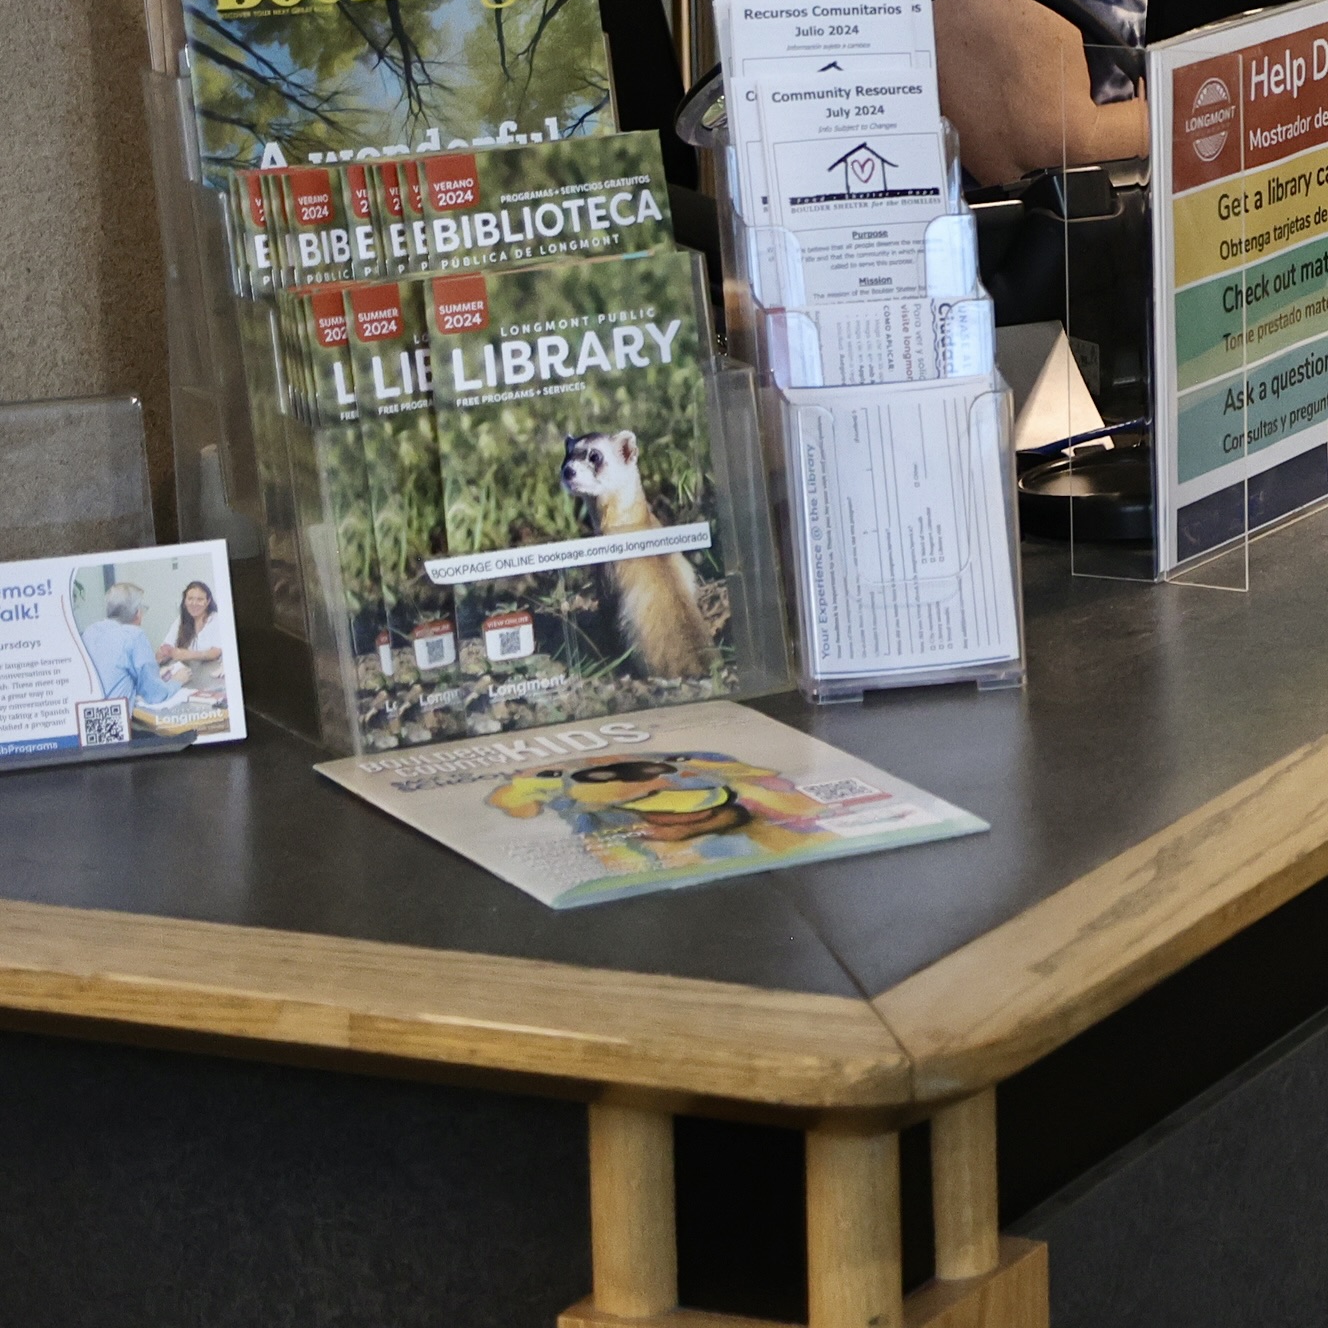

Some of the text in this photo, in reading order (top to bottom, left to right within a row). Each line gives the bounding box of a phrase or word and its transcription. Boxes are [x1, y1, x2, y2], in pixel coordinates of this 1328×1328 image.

[744, 3, 902, 20] Recursos Comunitarios
[795, 25, 859, 38] Julio 2024
[1250, 49, 1306, 103] Help
[772, 84, 922, 103] Community Resources
[826, 105, 885, 119] July 2024
[1185, 106, 1236, 133] LONGMONT
[834, 125, 859, 133] Subject
[1249, 114, 1311, 151] Mostrador
[434, 178, 474, 191] VERANO
[501, 174, 650, 204] PROGRAMAS SERVICIOS GRATUITOS
[1217, 185, 1250, 221] Get
[1254, 190, 1264, 210] a
[1267, 165, 1313, 208] library
[298, 194, 328, 206] VERANO
[438, 190, 473, 206] 2024
[791, 205, 830, 214] BOULDER
[302, 206, 328, 220] 2024
[432, 189, 663, 253] BIBLIOTECA
[852, 231, 888, 239] Purpose
[1219, 232, 1271, 261] Obtenga
[1273, 211, 1311, 244] tarjetas
[1314, 207, 1327, 226] de
[441, 233, 620, 270] PÚBLICA DE LONGMONT
[859, 277, 892, 287] Mission
[1222, 275, 1271, 314] Check
[1273, 266, 1297, 294] out
[358, 308, 398, 322] SUMMER
[439, 301, 484, 315] SUMMER
[901, 304, 910, 333] visite
[913, 303, 921, 328] Para
[363, 320, 397, 337] 2024
[444, 313, 482, 330] 2024
[500, 307, 656, 337] LONGMONT PUBLIC
[1222, 329, 1255, 353] Tome
[1256, 306, 1302, 345] prestado
[451, 319, 681, 392] LIBRARY
[456, 382, 586, 408] FREE PROGRAMS SERVICES
[1223, 377, 1255, 416] Ask
[1258, 381, 1267, 401] a
[378, 405, 399, 415] FREE
[1222, 419, 1278, 454] Consultas
[1280, 416, 1287, 433] y
[806, 444, 831, 660] Your Experience @ the Library
[431, 561, 492, 579] BOOKPAGE
[495, 554, 534, 570] ONLINE
[0, 579, 53, 598] mos!
[0, 603, 40, 621] alk!
[488, 673, 566, 698] Longmont
[155, 709, 224, 726] Longmont
[494, 721, 650, 765] KIDS
